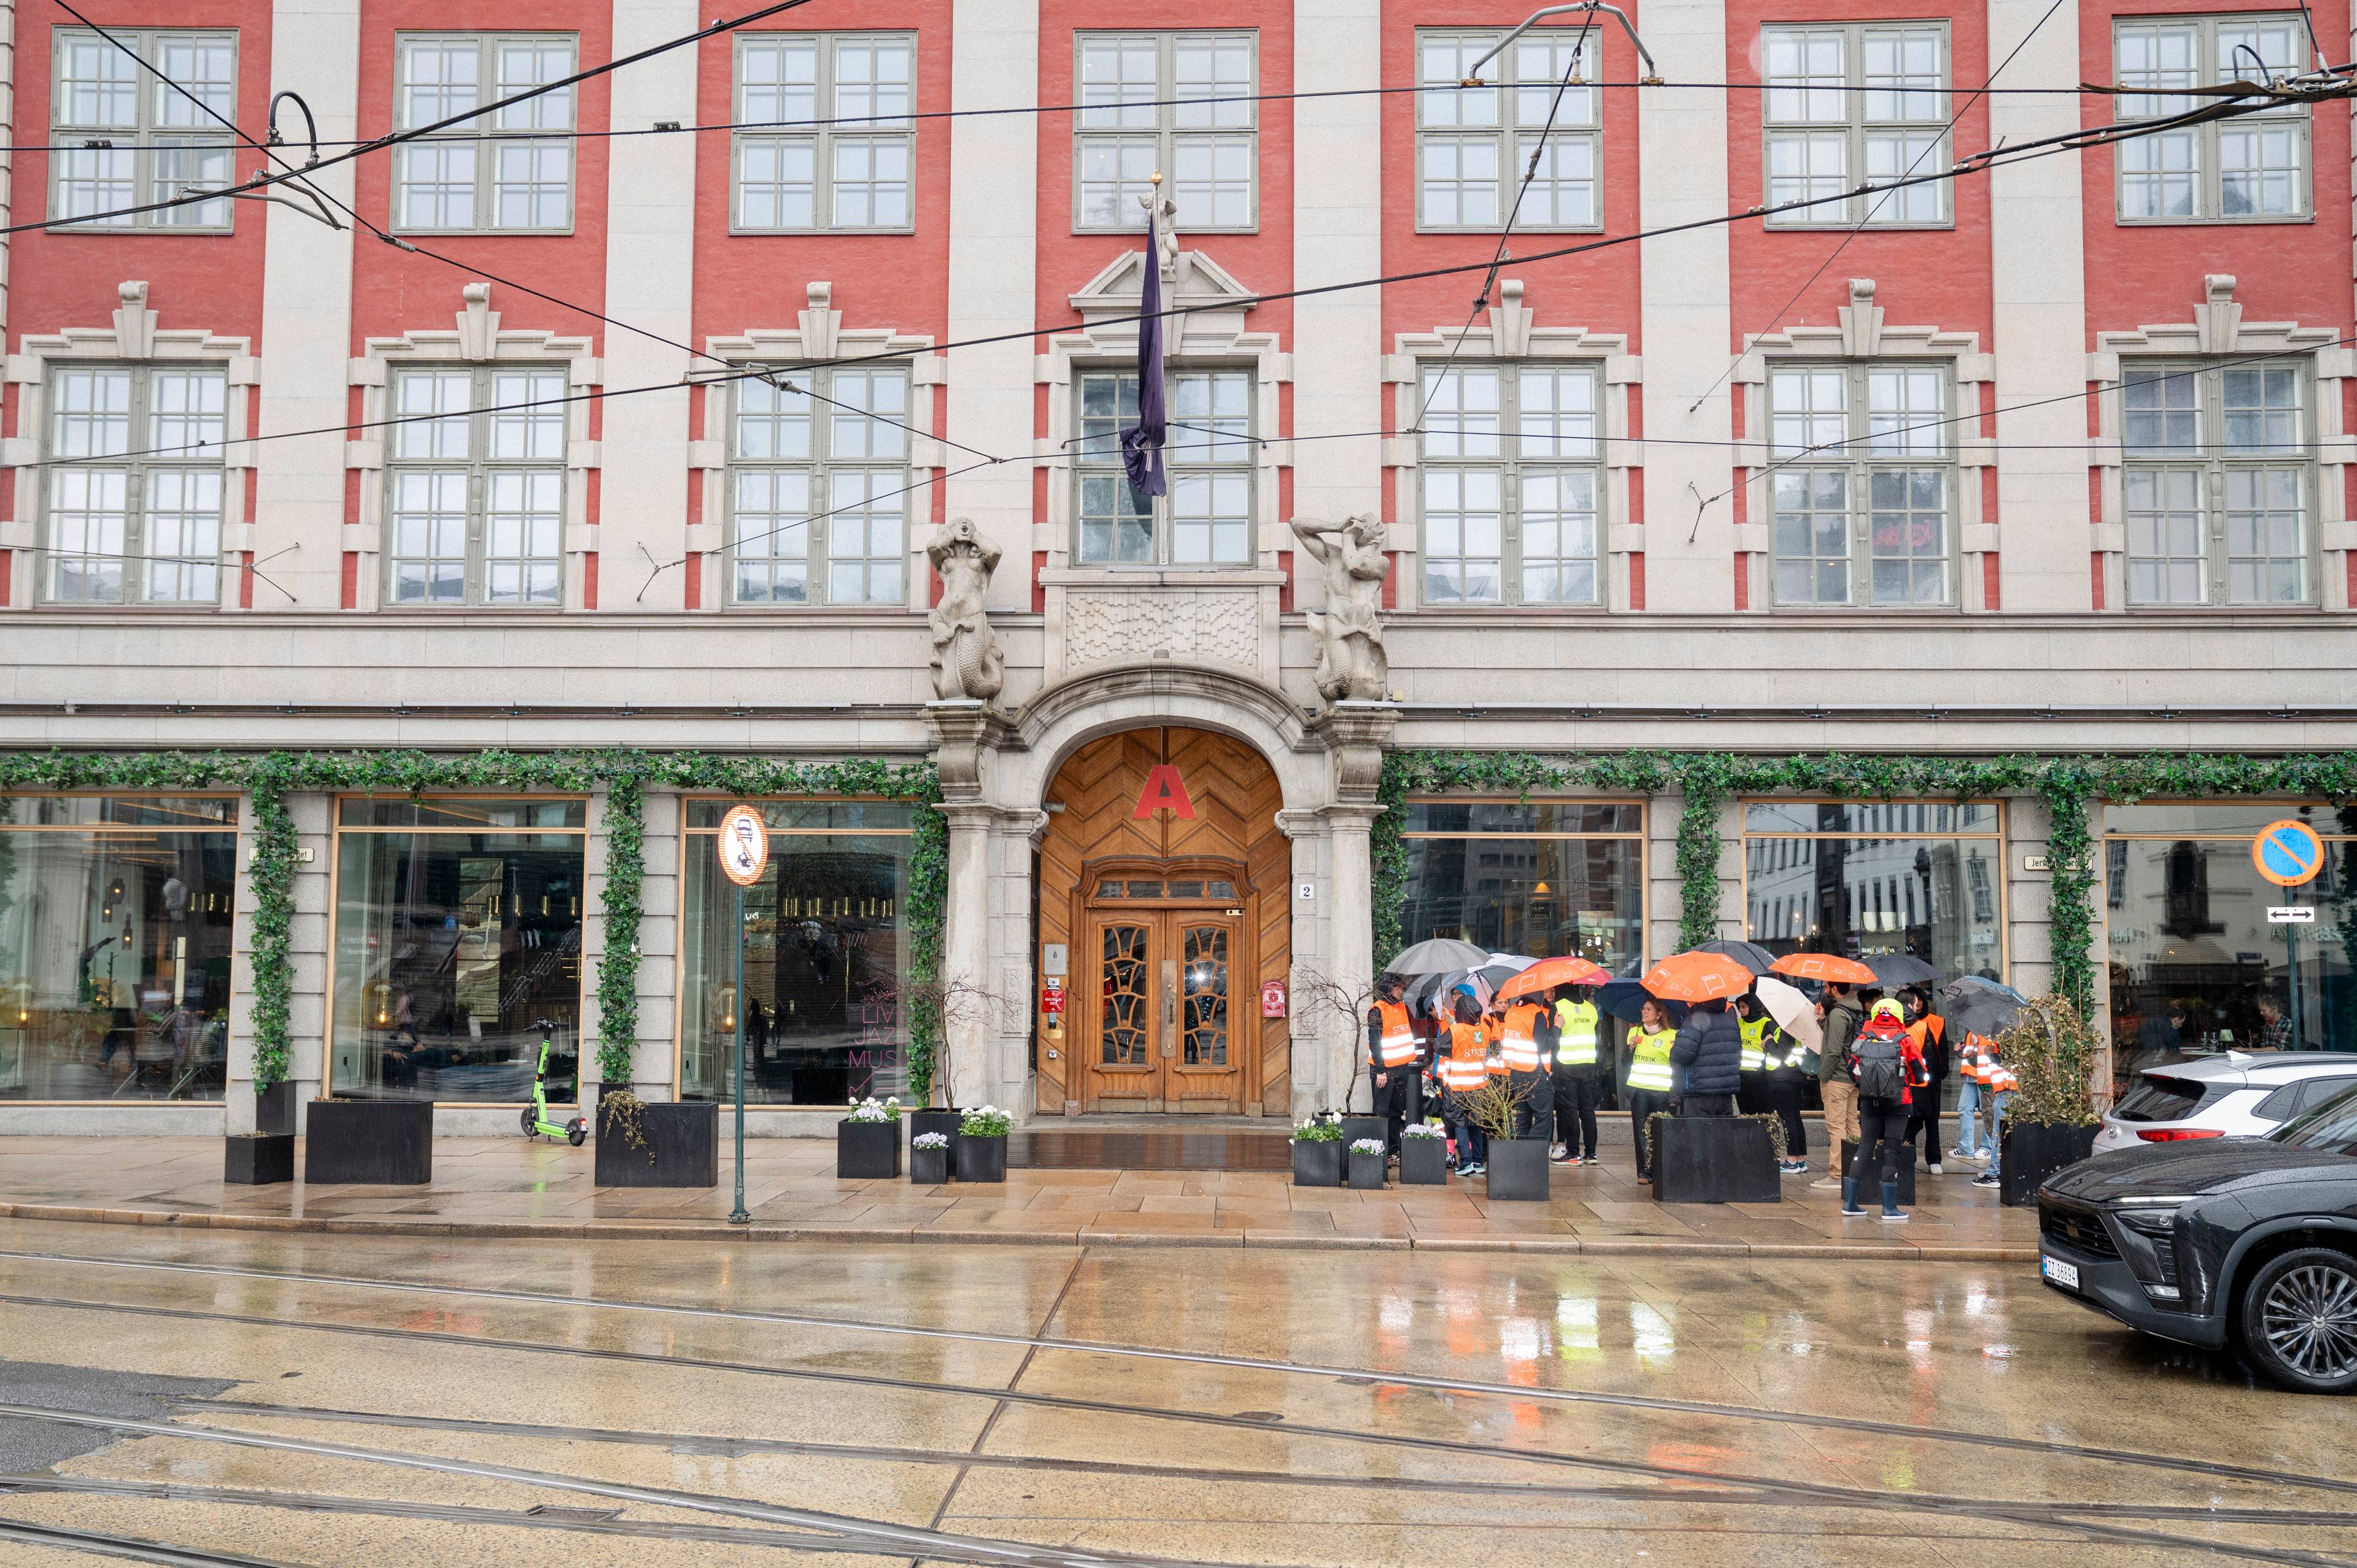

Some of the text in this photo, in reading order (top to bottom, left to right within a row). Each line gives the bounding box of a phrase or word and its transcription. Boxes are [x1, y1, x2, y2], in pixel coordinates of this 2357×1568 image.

[1133, 765, 1196, 819] A
[1303, 886, 1310, 897] 2
[849, 1050, 909, 1068] MUSI
[2057, 1264, 2076, 1284] 36894
